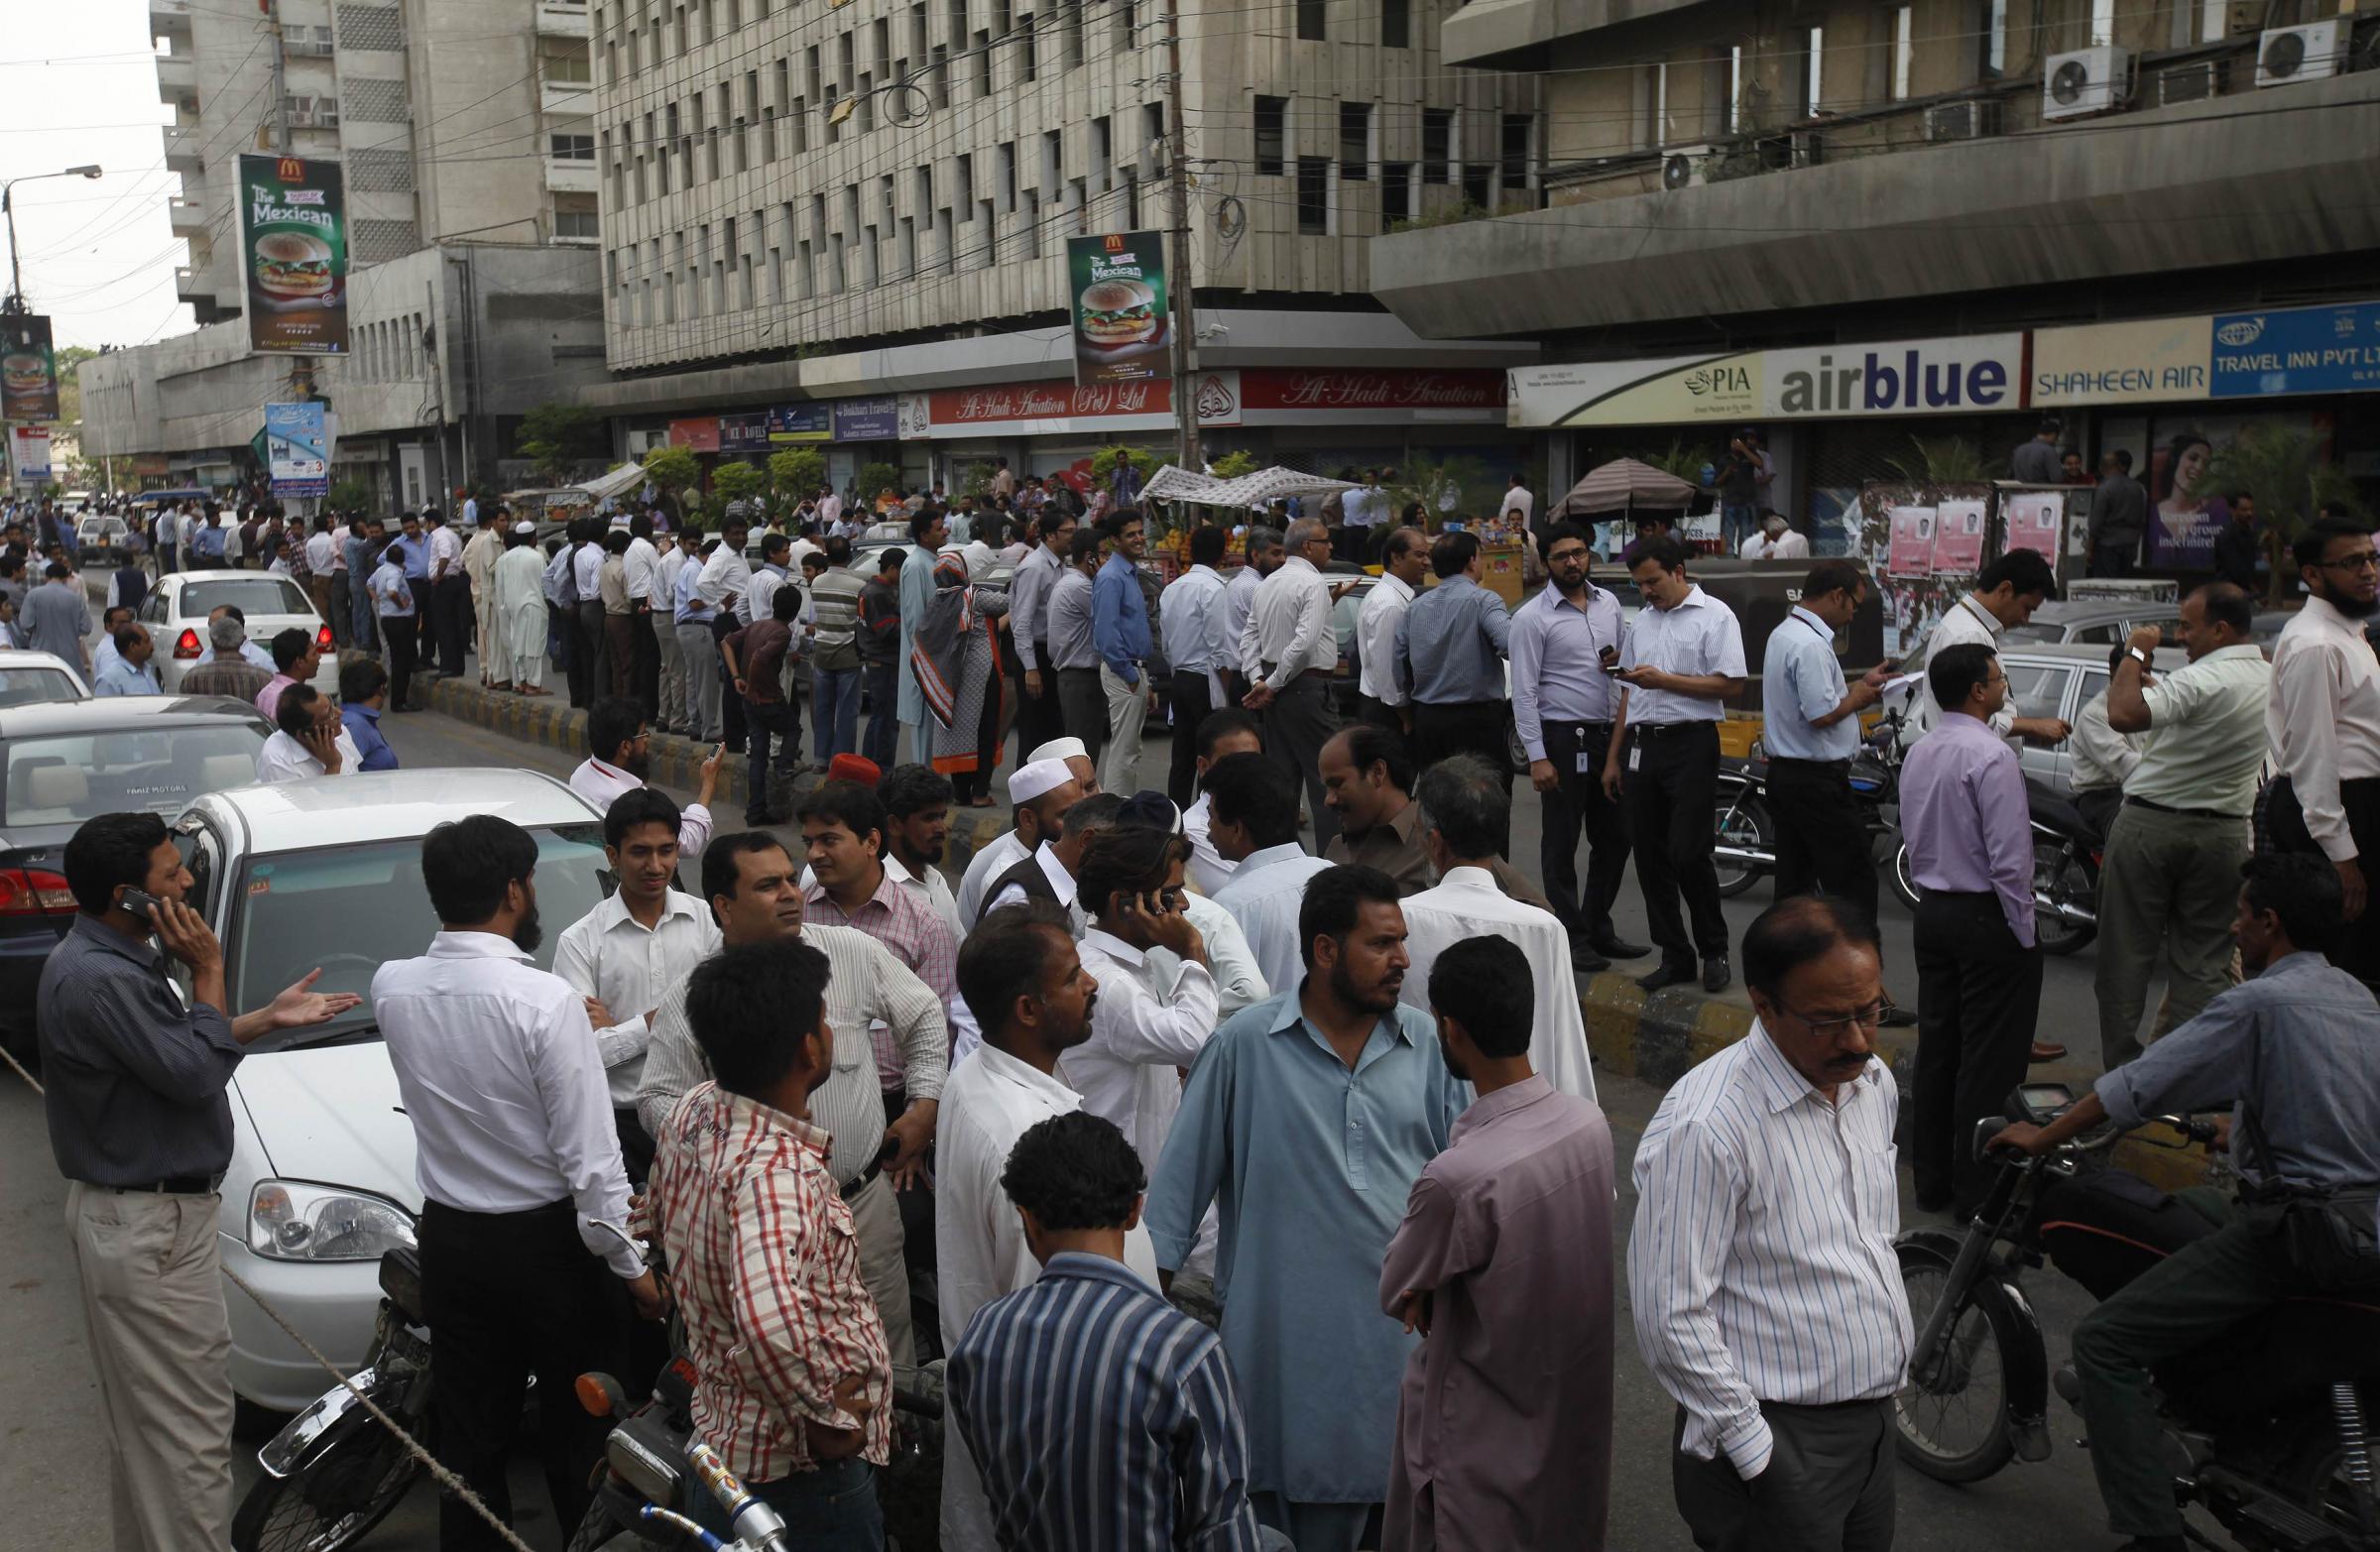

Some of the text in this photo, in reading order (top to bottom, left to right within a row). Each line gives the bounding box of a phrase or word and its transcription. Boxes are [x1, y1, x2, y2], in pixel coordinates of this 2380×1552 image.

[251, 183, 276, 204] The
[252, 203, 334, 229] Mexican
[1090, 255, 1106, 267] The
[1091, 265, 1142, 284] Mexican
[2216, 352, 2283, 373] TRAVEL
[2287, 349, 2319, 369] INN
[2322, 347, 2359, 366] PVT
[1280, 373, 1388, 405] Al-Hadi
[1393, 374, 1486, 404] Aviation
[1713, 367, 1751, 392] PIA
[1780, 350, 2007, 413] airblue
[2038, 365, 2204, 396] SHAHEEN AIR
[956, 395, 1011, 419] Al-Hadi
[1012, 388, 1066, 416] Aviation
[1072, 384, 1112, 415] (Pvt)
[1117, 383, 1147, 410] Ltd
[2160, 511, 2210, 524] Boredom
[2159, 535, 2215, 548] indefinitel
